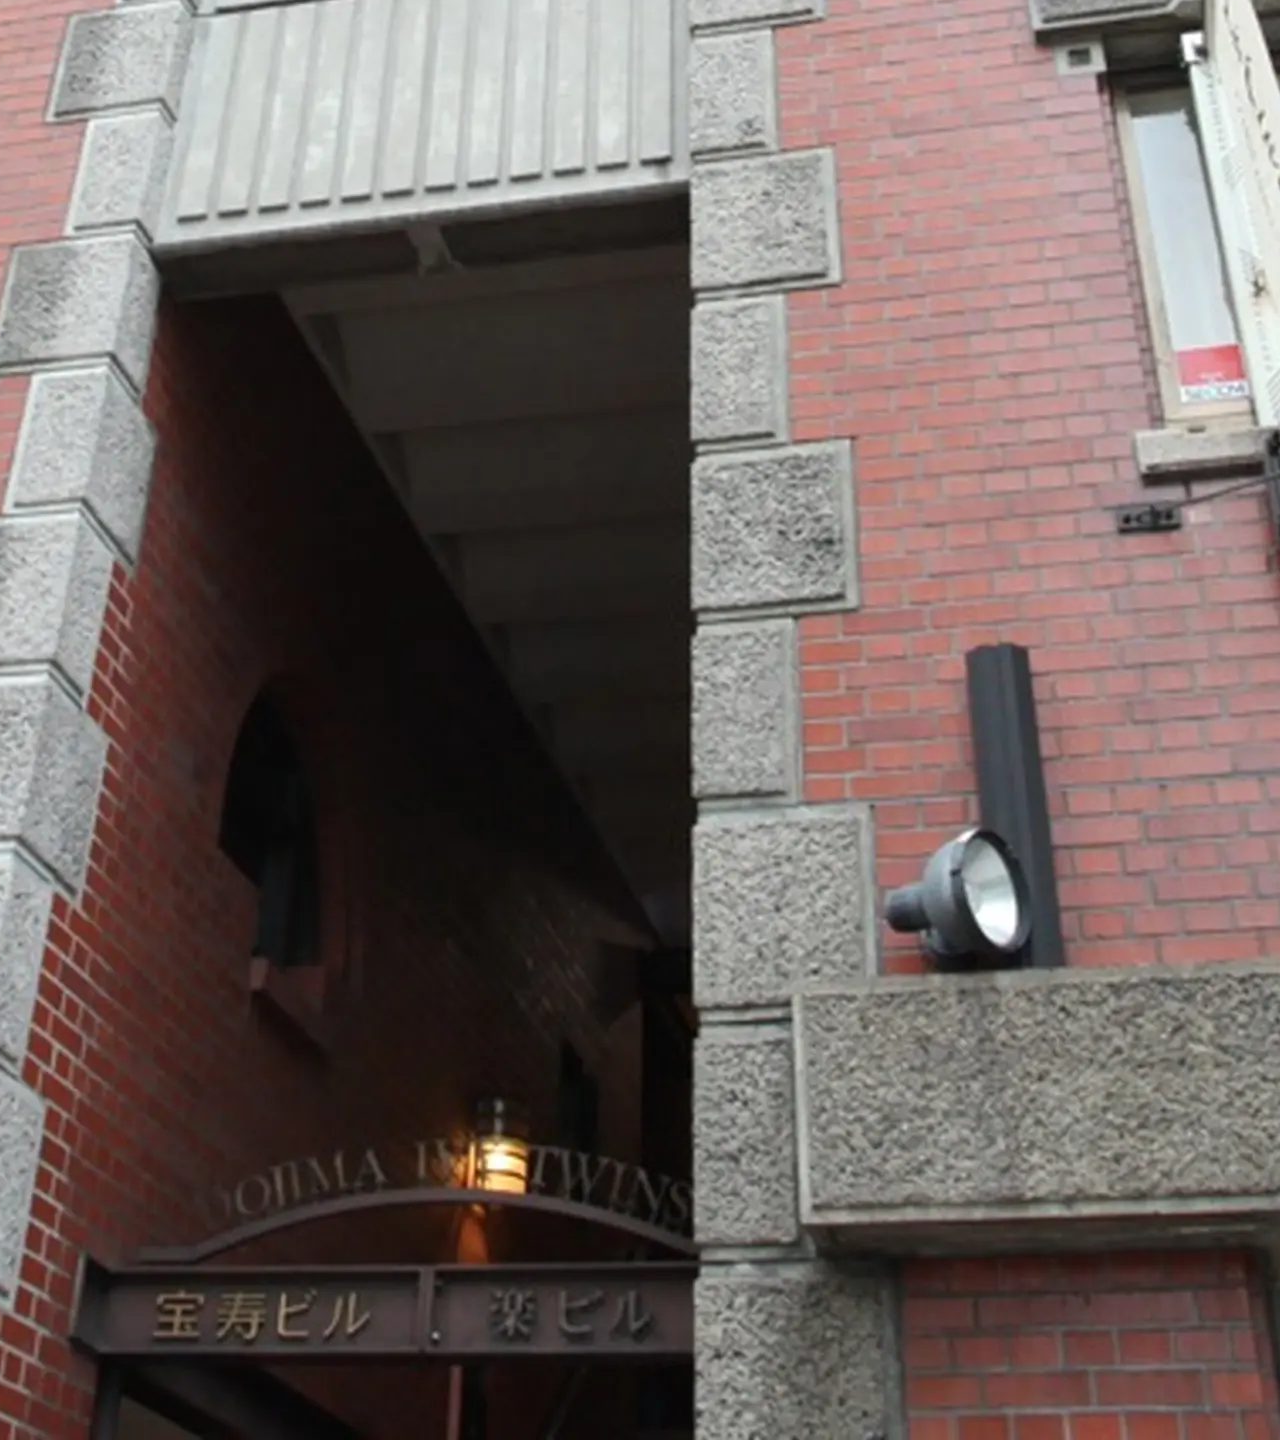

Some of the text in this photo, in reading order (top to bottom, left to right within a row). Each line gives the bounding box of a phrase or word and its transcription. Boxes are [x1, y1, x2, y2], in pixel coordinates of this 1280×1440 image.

[152, 1287, 656, 1344] 宝寿ビル 楽ビル
